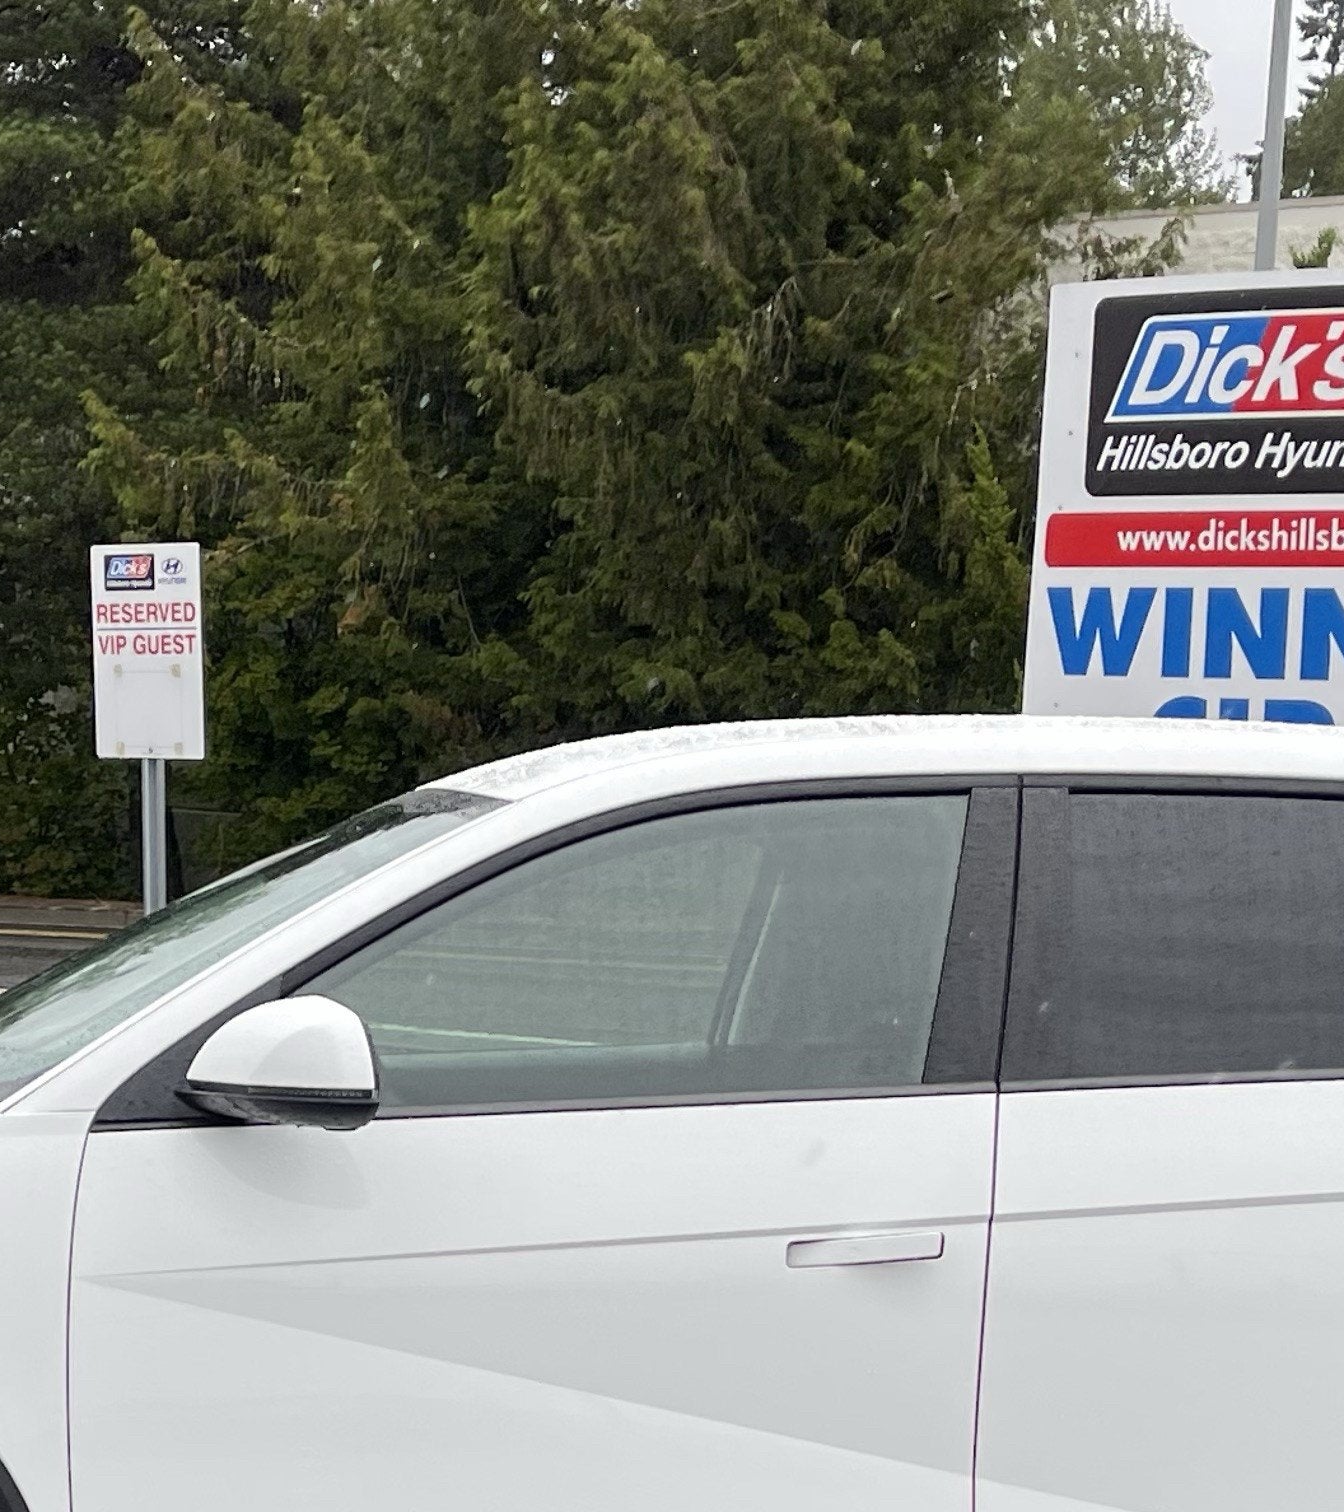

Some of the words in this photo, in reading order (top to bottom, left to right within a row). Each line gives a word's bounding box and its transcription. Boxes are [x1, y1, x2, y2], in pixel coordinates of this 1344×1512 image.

[1096, 433, 1250, 472] Hillsboro
[96, 602, 197, 624] RESERVED
[98, 635, 127, 655] VIP
[133, 634, 197, 655] GUEST
